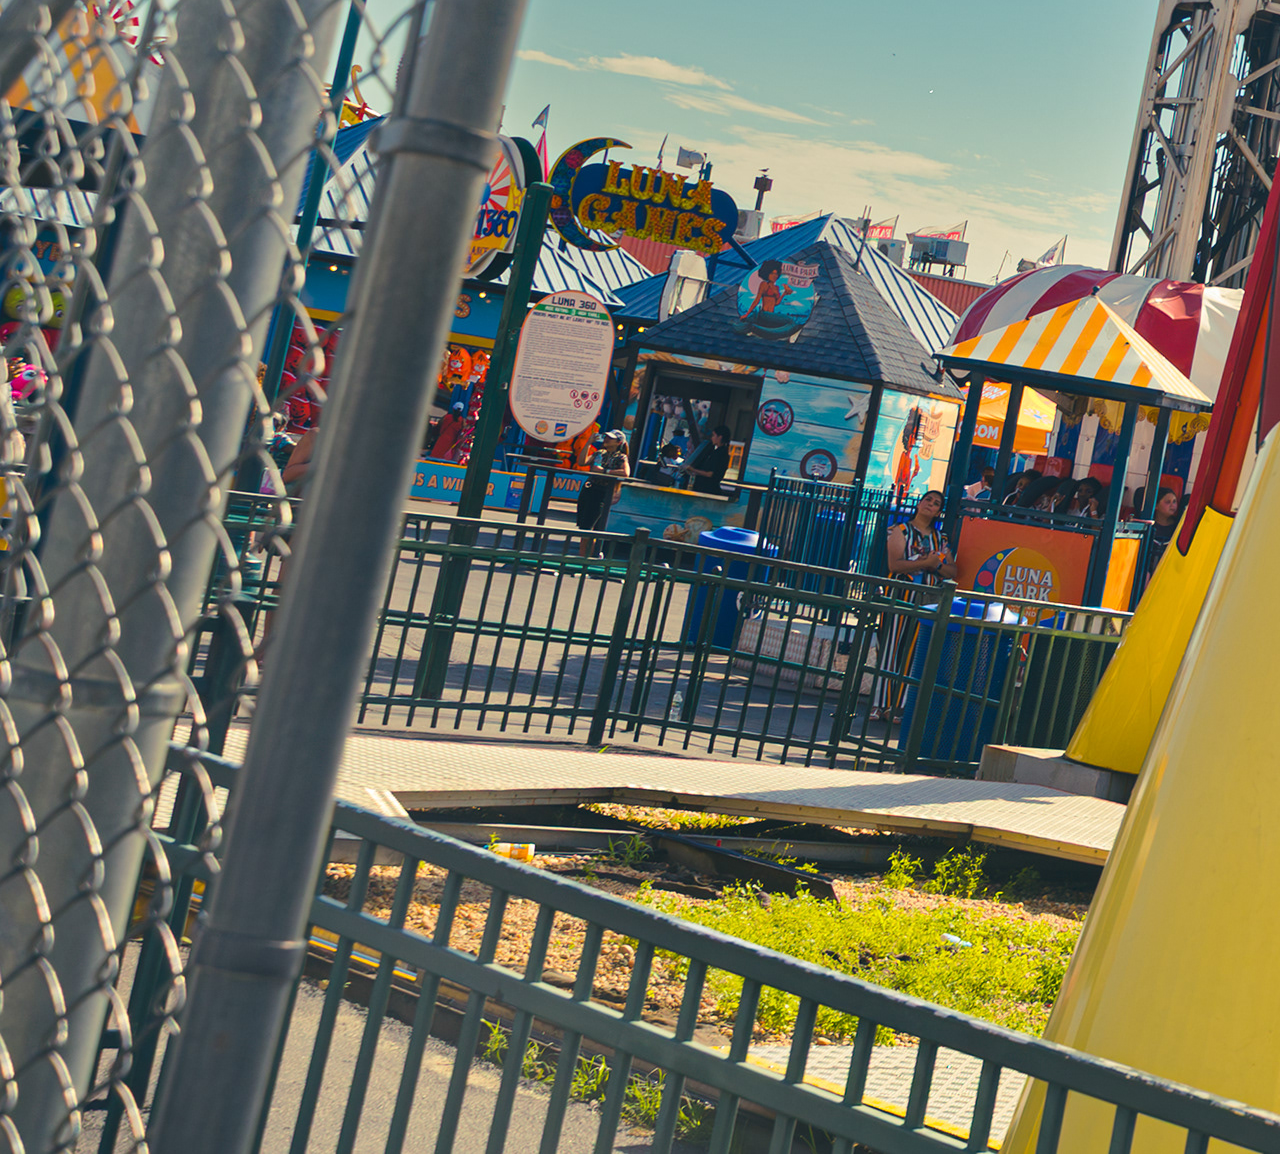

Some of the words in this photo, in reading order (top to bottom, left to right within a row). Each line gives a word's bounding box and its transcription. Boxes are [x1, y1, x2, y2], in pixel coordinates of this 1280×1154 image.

[602, 159, 714, 214] LUNA
[578, 193, 727, 254] GAMES
[782, 262, 799, 274] LUNA
[800, 266, 817, 276] PARK
[789, 277, 809, 286] SLICE
[552, 296, 576, 307] LUNA
[579, 300, 597, 310] 360
[427, 474, 438, 488] A
[1004, 565, 1053, 587] LUNA
[1002, 581, 1051, 602] PARK
